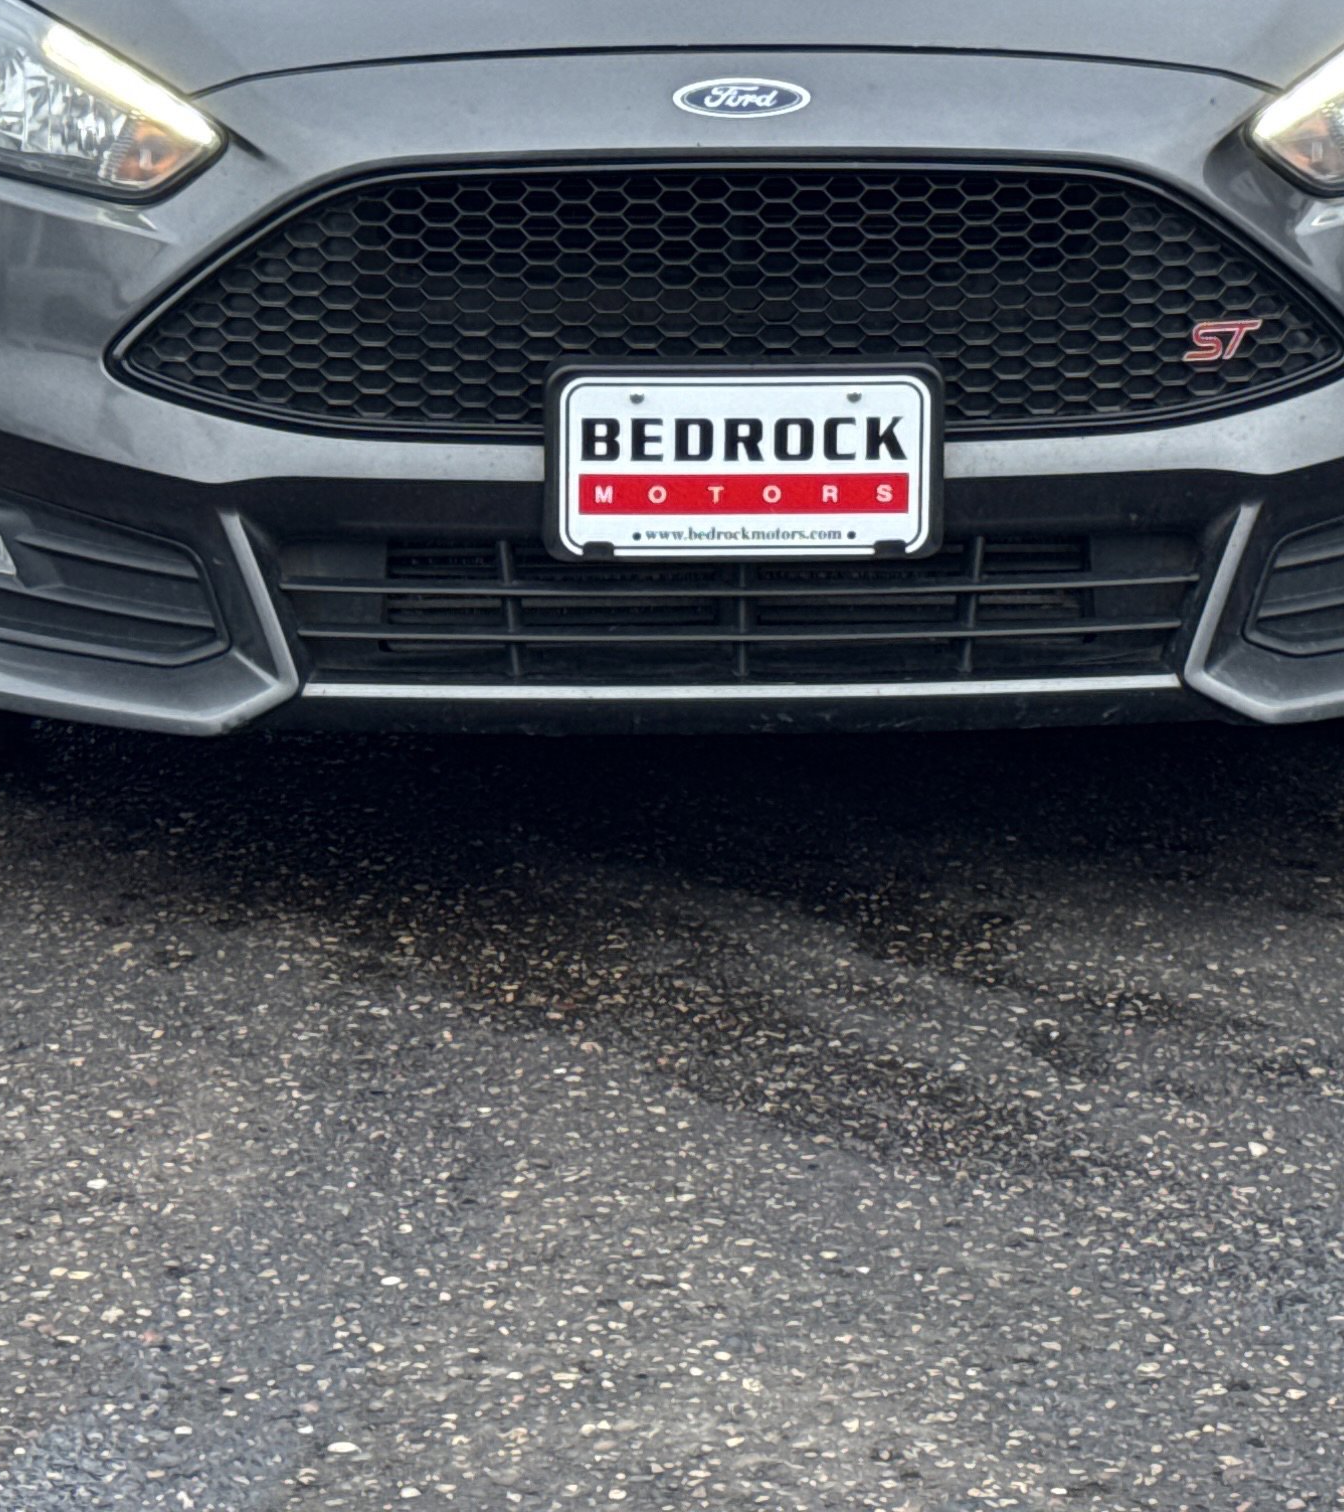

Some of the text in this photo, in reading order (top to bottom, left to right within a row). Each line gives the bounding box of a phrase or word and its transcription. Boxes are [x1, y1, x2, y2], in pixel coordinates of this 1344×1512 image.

[704, 85, 778, 108] Ford
[1182, 319, 1263, 362] ST
[580, 416, 908, 462] BEDROCK
[594, 484, 894, 504] MOTORS
[645, 526, 843, 542] www.bedrockmotors.com
